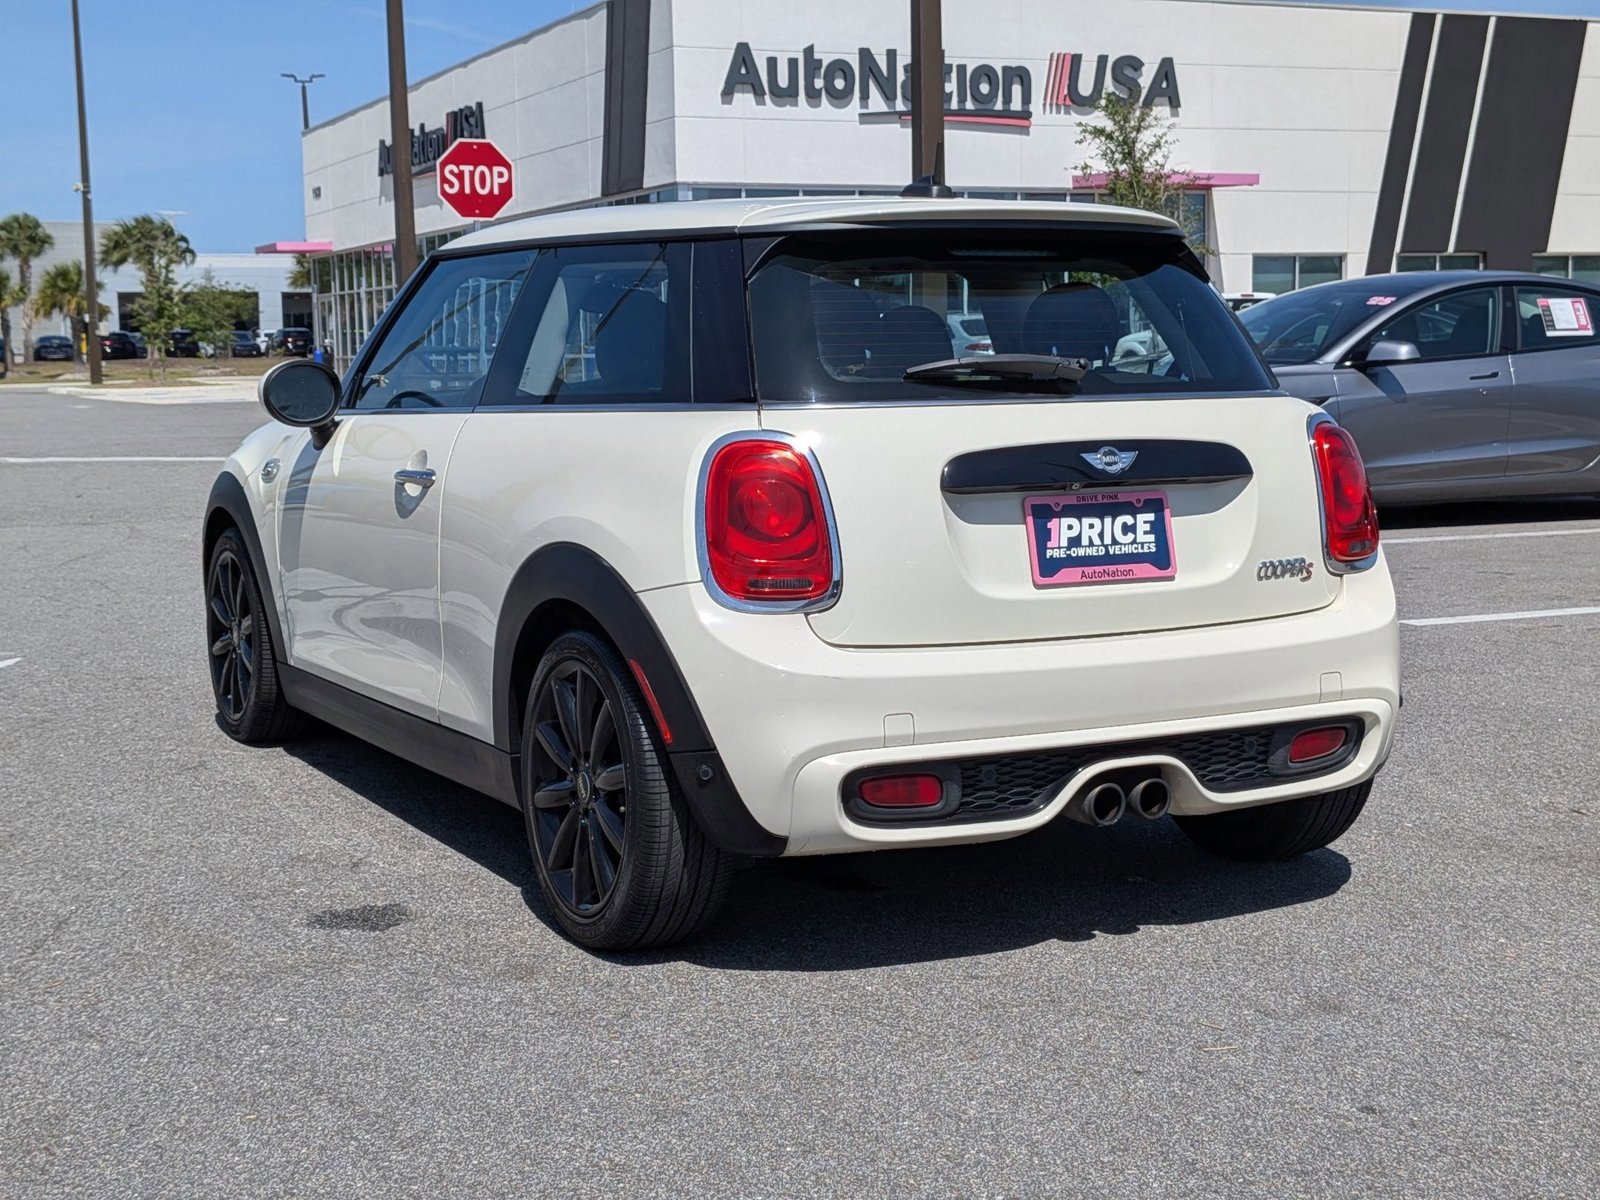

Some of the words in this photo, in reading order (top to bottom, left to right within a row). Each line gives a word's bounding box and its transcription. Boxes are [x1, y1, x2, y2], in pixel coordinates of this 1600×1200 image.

[1067, 53, 1181, 108] USA
[443, 164, 509, 195] STOP
[1076, 494, 1100, 503] DRIVE
[1101, 493, 1120, 501] PINK
[1046, 513, 1156, 548] 1PRICE
[1046, 546, 1106, 559] PRE-OWNED
[1108, 543, 1156, 555] VEHICLES
[1080, 567, 1135, 580] AutoNation
